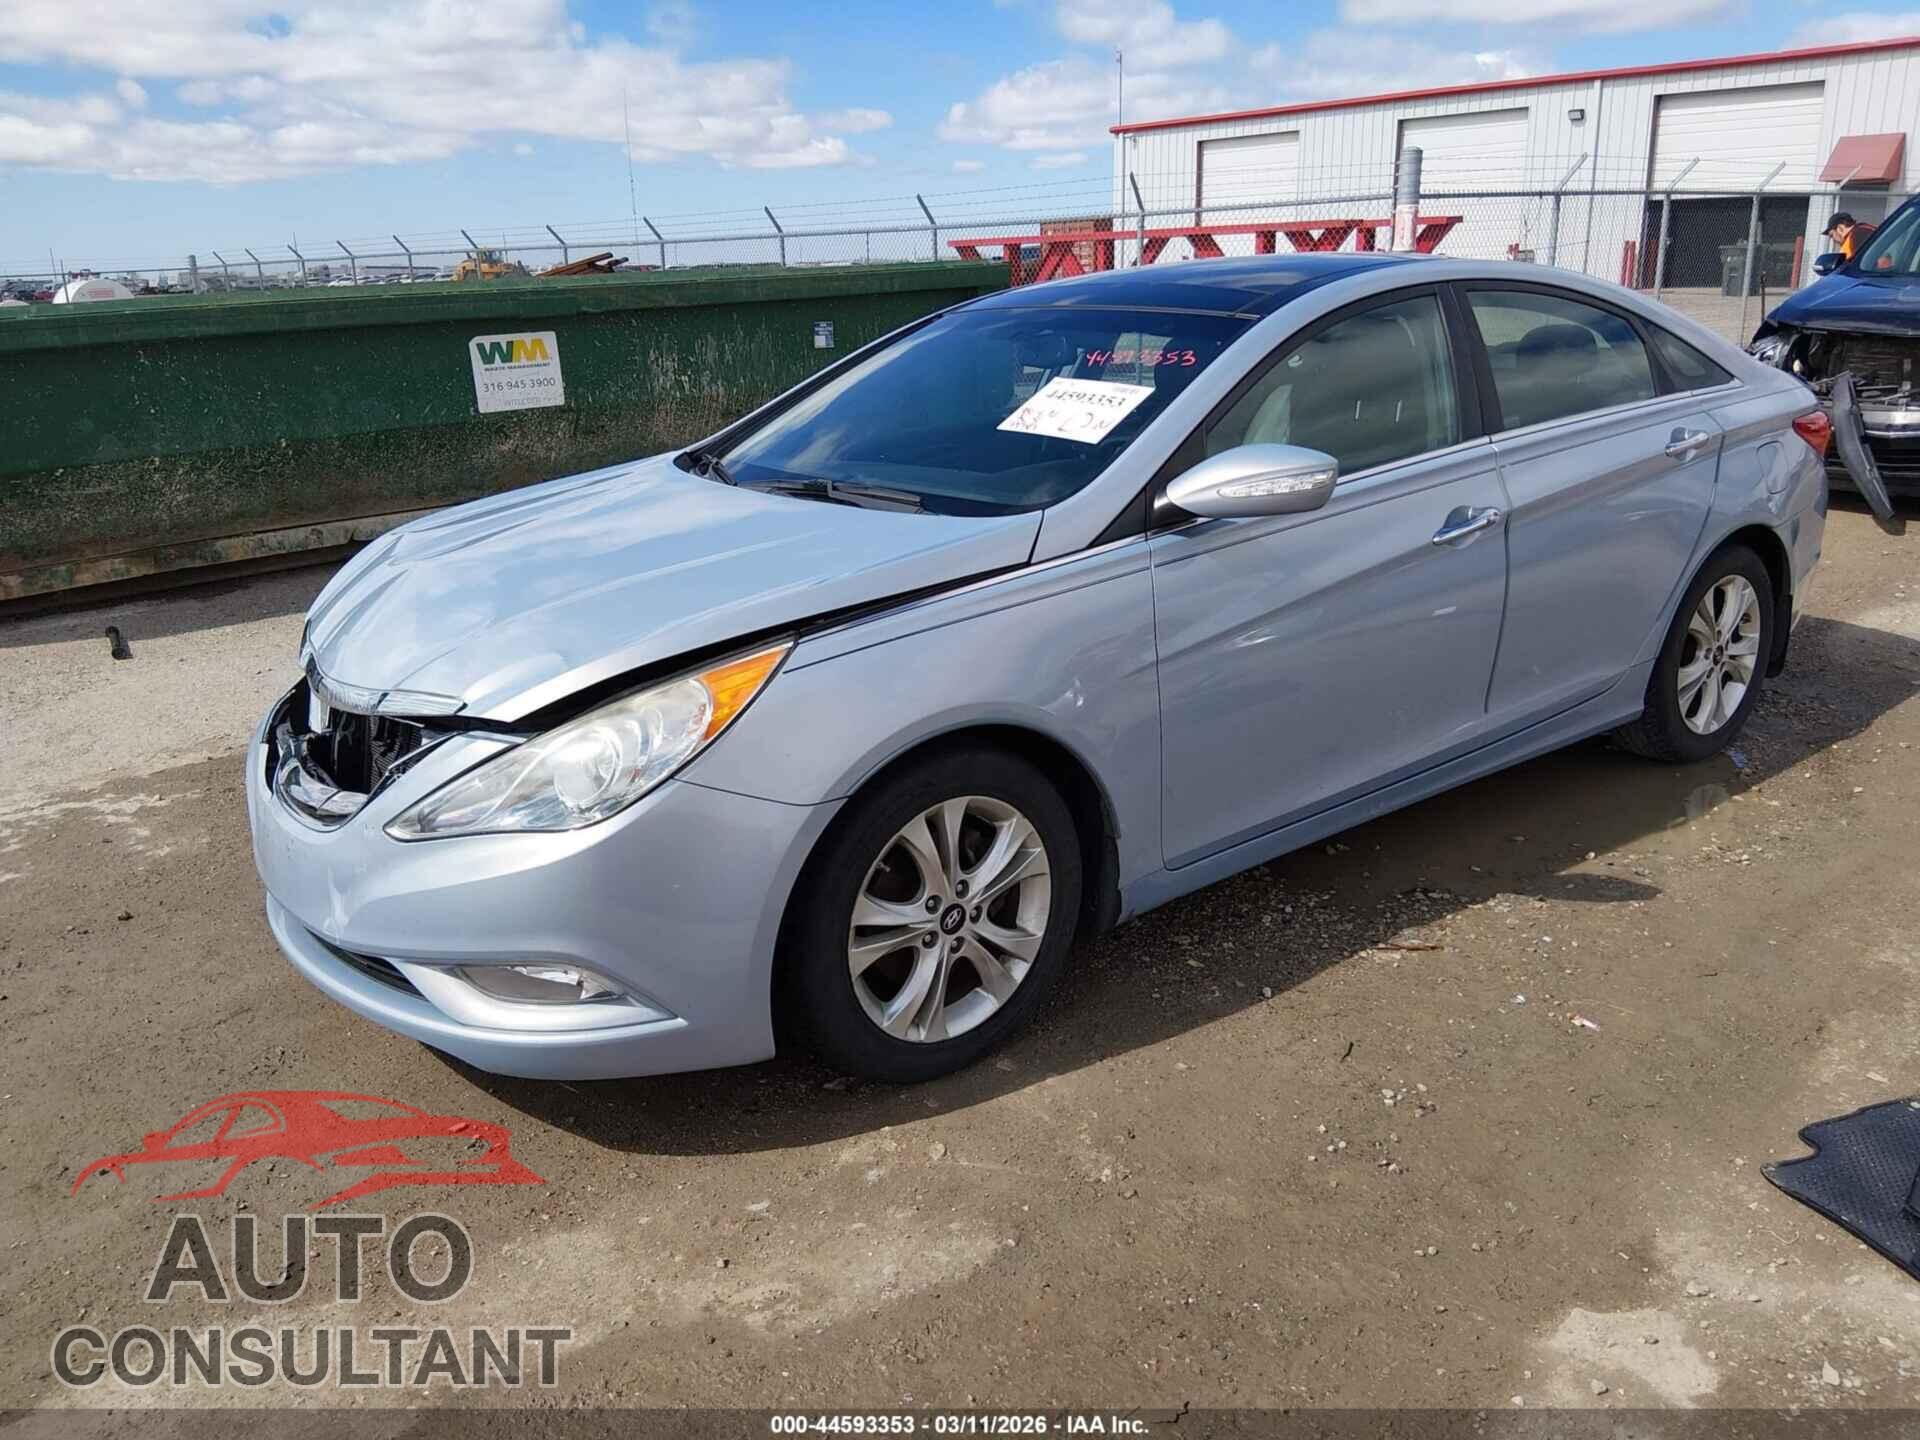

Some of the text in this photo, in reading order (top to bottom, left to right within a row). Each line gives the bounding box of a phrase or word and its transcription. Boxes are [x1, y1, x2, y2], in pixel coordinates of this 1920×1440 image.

[476, 338, 549, 365] WM
[483, 376, 556, 393] 316 945 3900
